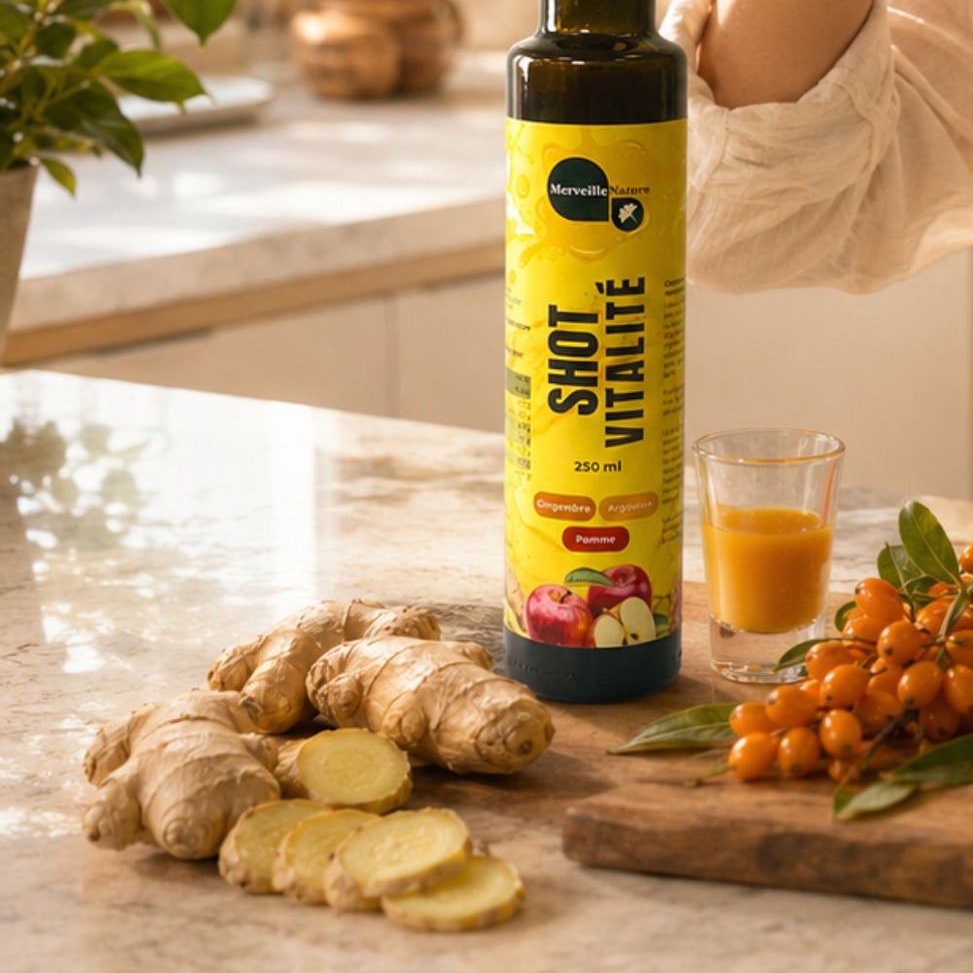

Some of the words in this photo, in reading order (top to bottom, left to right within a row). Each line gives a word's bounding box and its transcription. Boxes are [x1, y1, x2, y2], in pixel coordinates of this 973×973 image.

[550, 182, 608, 197] Merveille
[548, 304, 599, 416] SHOT
[595, 277, 645, 448] VITALITÉ
[574, 460, 600, 473] 250
[604, 460, 622, 472] ml
[575, 534, 616, 545] Pomme
